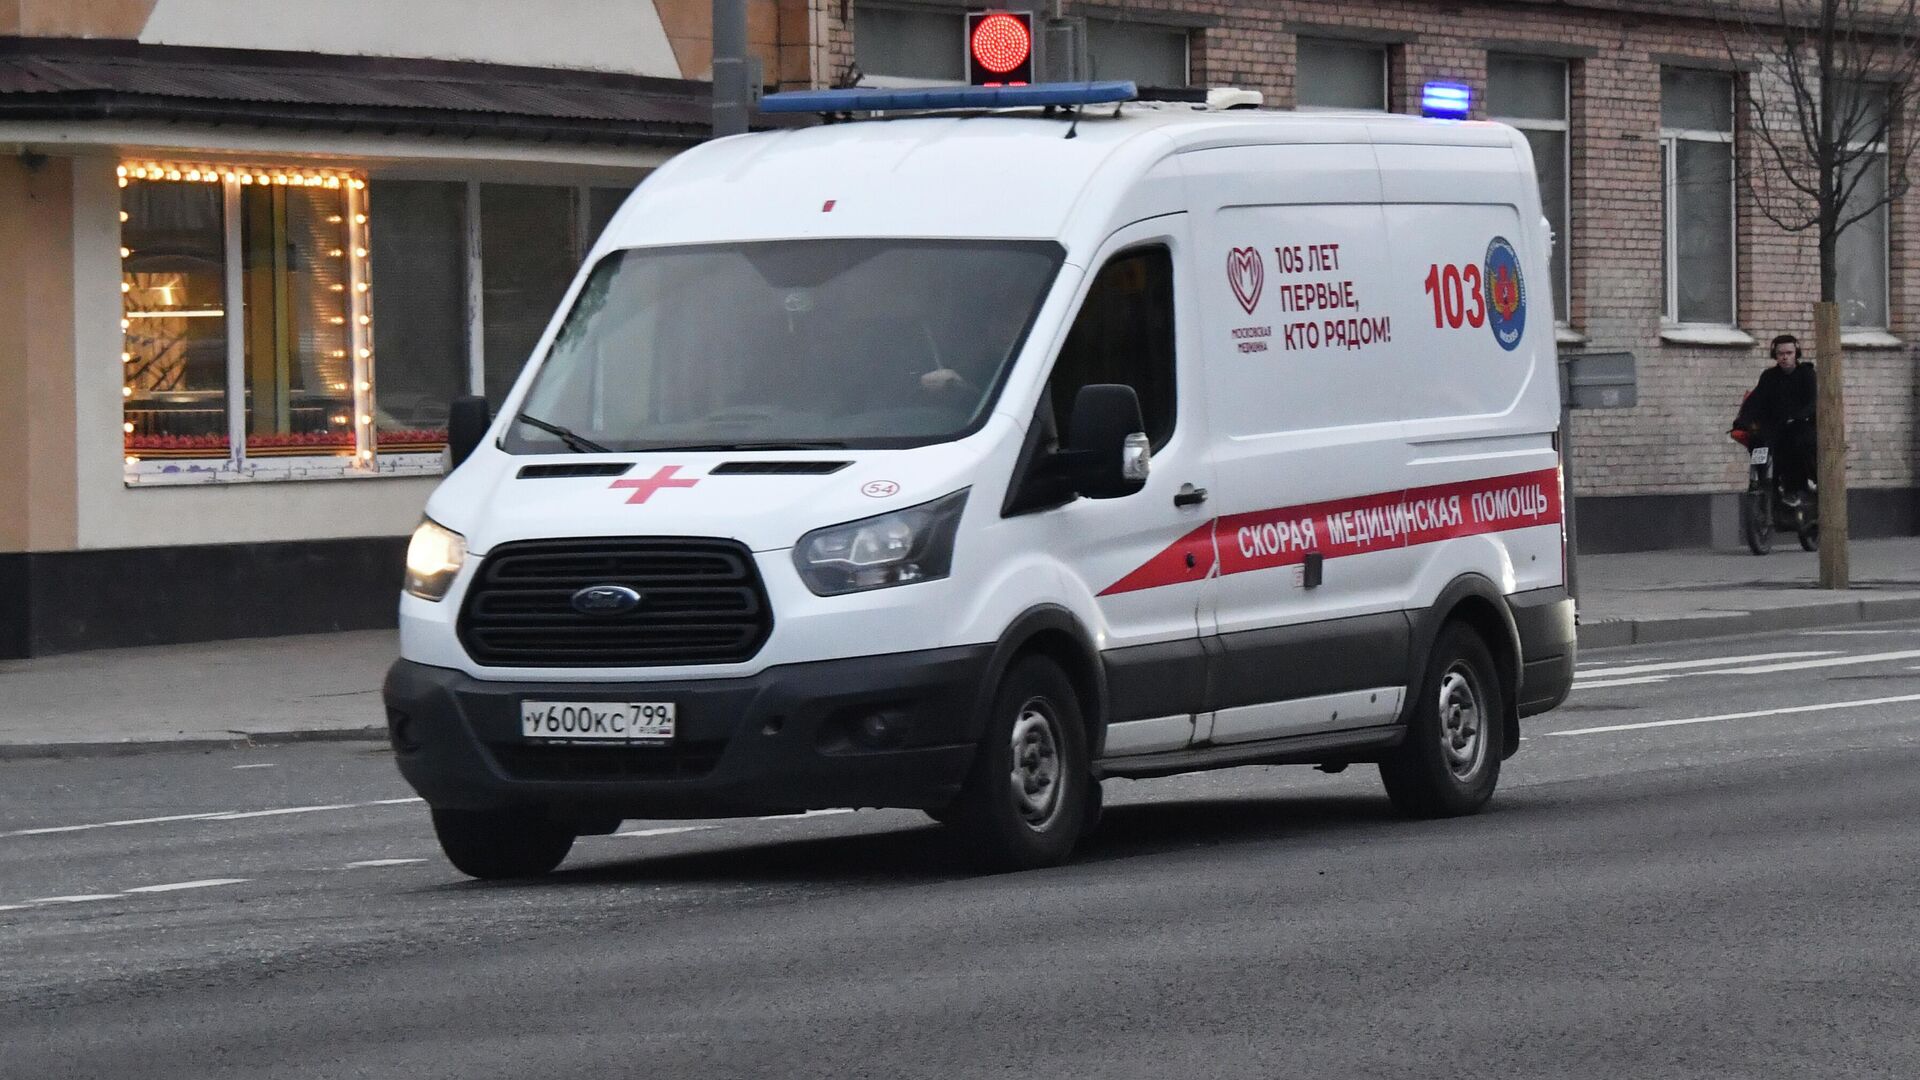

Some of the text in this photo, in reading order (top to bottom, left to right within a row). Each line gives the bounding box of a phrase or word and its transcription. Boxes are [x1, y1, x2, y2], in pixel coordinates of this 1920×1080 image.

[1274, 244, 1339, 273] 105 ЛЕТ
[1280, 281, 1359, 312] ПЕРВЫЕ,
[1424, 263, 1486, 329] 103
[1284, 316, 1391, 350] КТО РЯДОМ!
[867, 484, 894, 494] 54
[1237, 483, 1548, 559] СКОРАЯ МЕДИЦИНСКАЯ ПОМОЩЬ
[629, 705, 668, 726] 799
